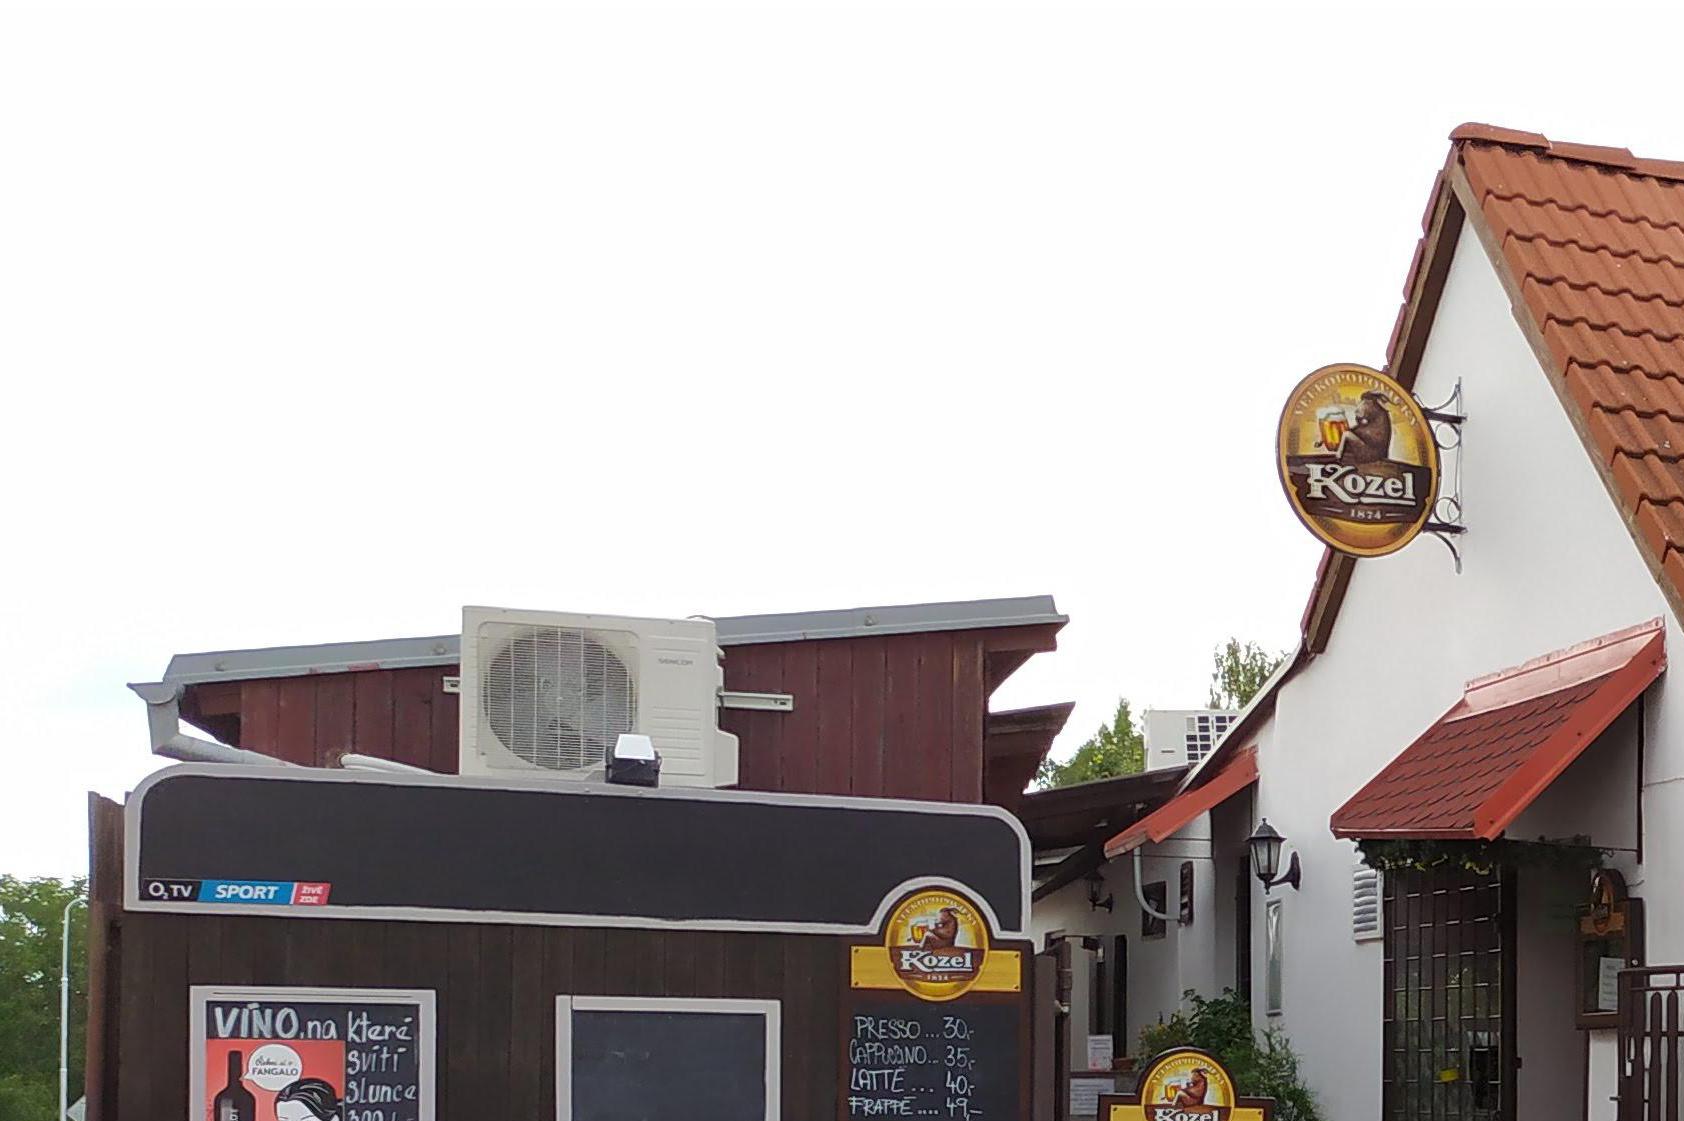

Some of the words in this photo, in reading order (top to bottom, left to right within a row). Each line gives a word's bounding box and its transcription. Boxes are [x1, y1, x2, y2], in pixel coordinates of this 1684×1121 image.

[1305, 464, 1416, 504] Kozel
[170, 884, 192, 898] TV
[215, 885, 279, 900] SPORT
[900, 950, 973, 972] Kozel
[307, 1019, 337, 1040] na
[855, 1016, 920, 1039] PRESSO
[252, 1067, 299, 1076] FANGALO
